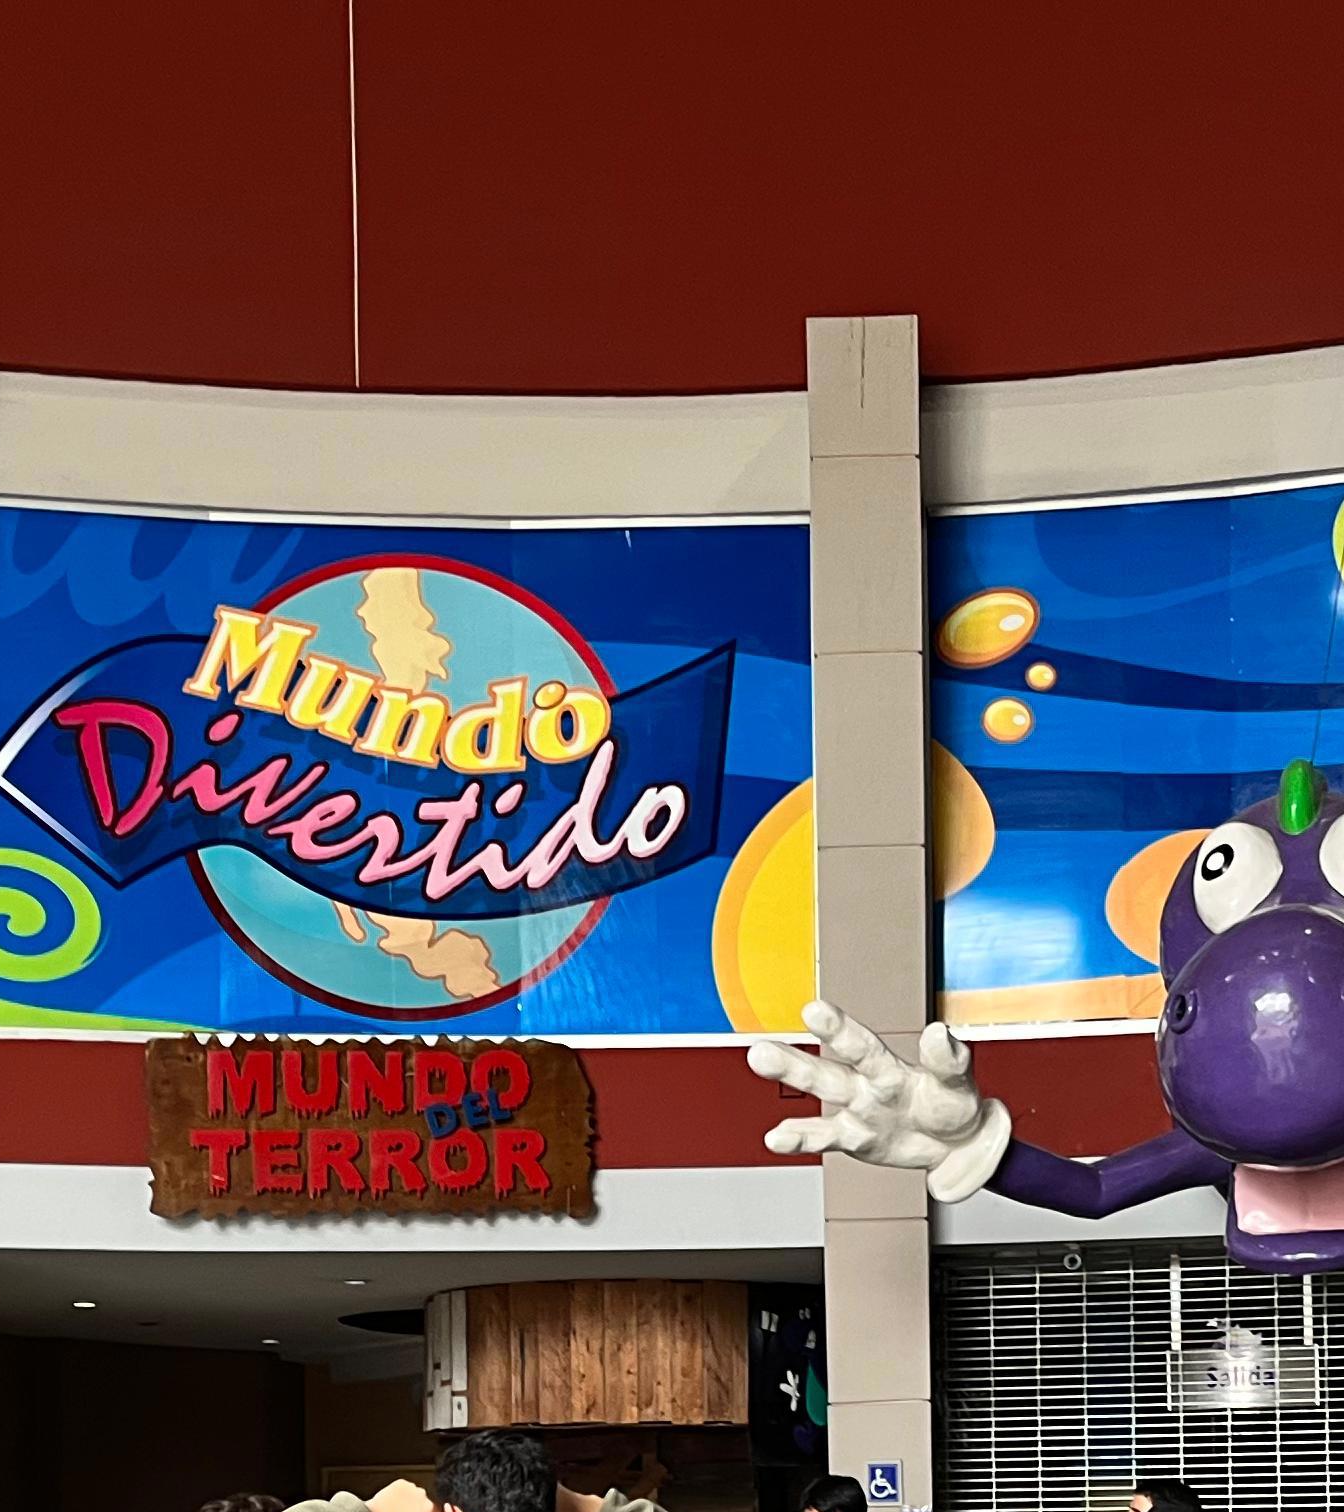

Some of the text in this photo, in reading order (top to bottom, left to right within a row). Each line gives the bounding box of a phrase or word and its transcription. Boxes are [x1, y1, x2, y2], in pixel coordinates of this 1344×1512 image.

[182, 604, 613, 774] Mundo
[55, 698, 689, 901] Divertido
[206, 1049, 532, 1119] MUNDO
[423, 1088, 512, 1139] DEL
[189, 1129, 552, 1201] TERROR
